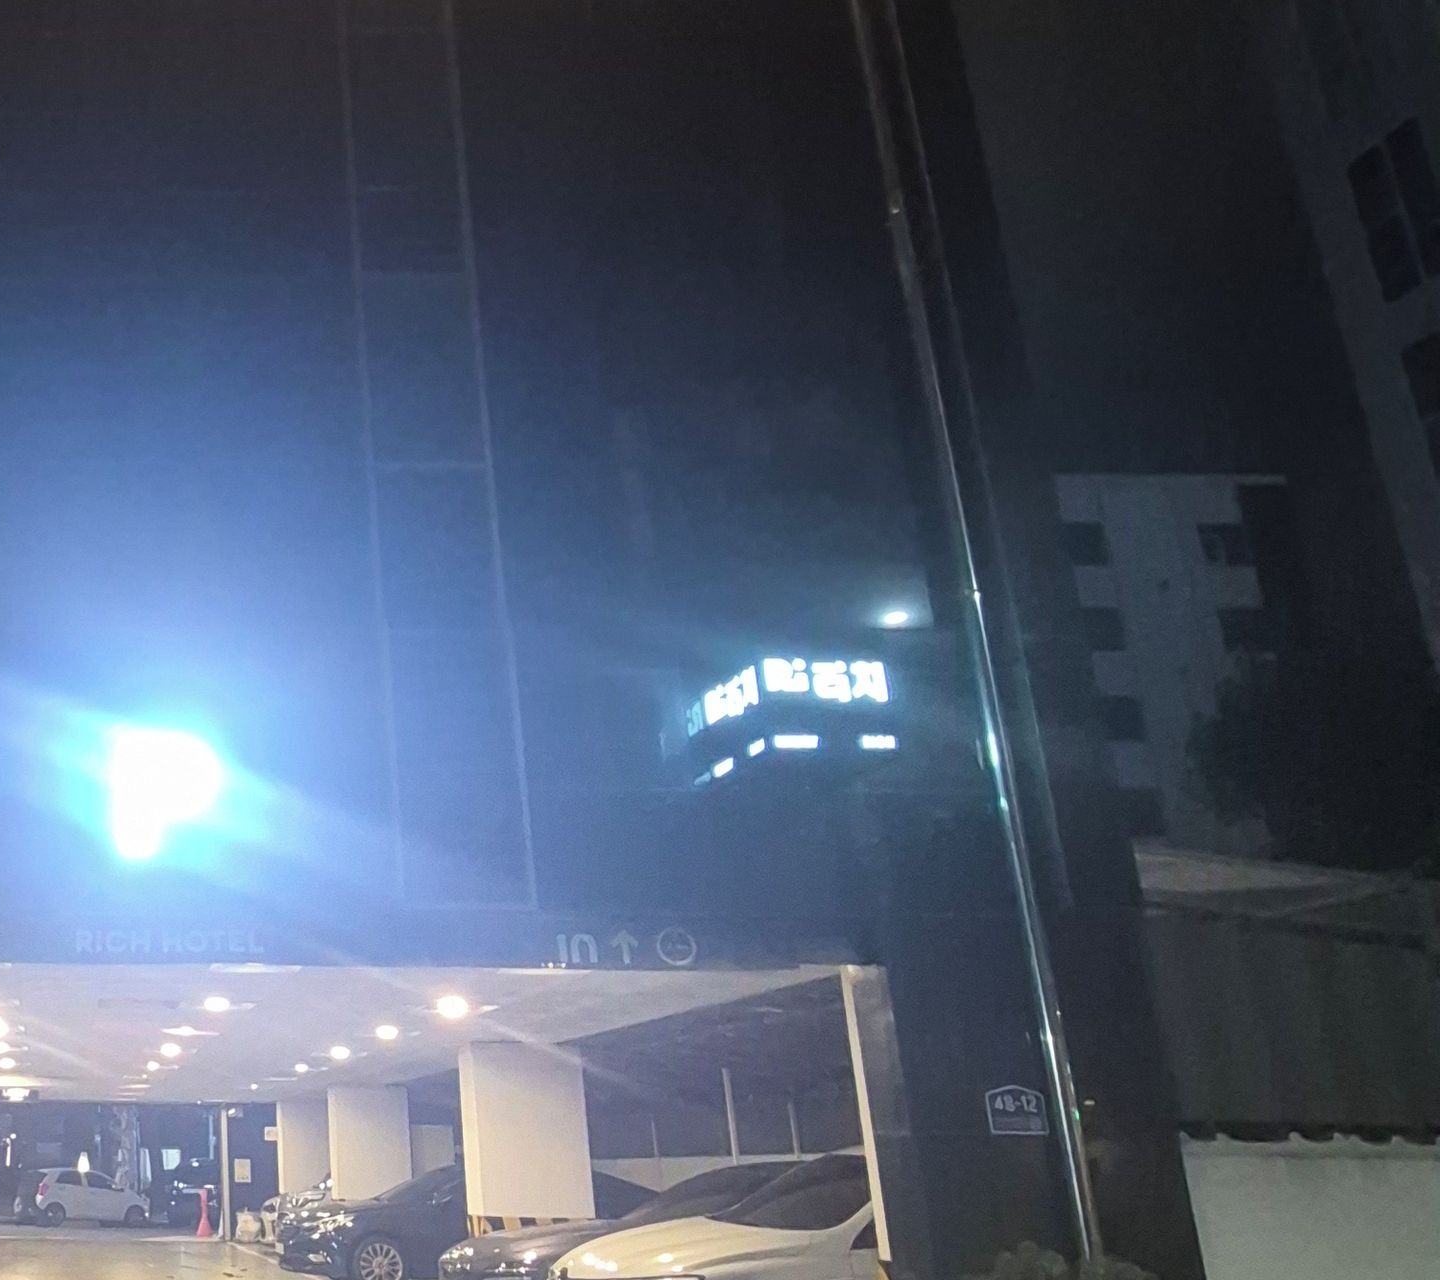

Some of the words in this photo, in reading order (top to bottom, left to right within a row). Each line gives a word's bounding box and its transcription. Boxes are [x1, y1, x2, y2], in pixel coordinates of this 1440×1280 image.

[111, 725, 223, 860] P
[75, 930, 151, 953] RICH
[161, 928, 265, 953] HOTEL
